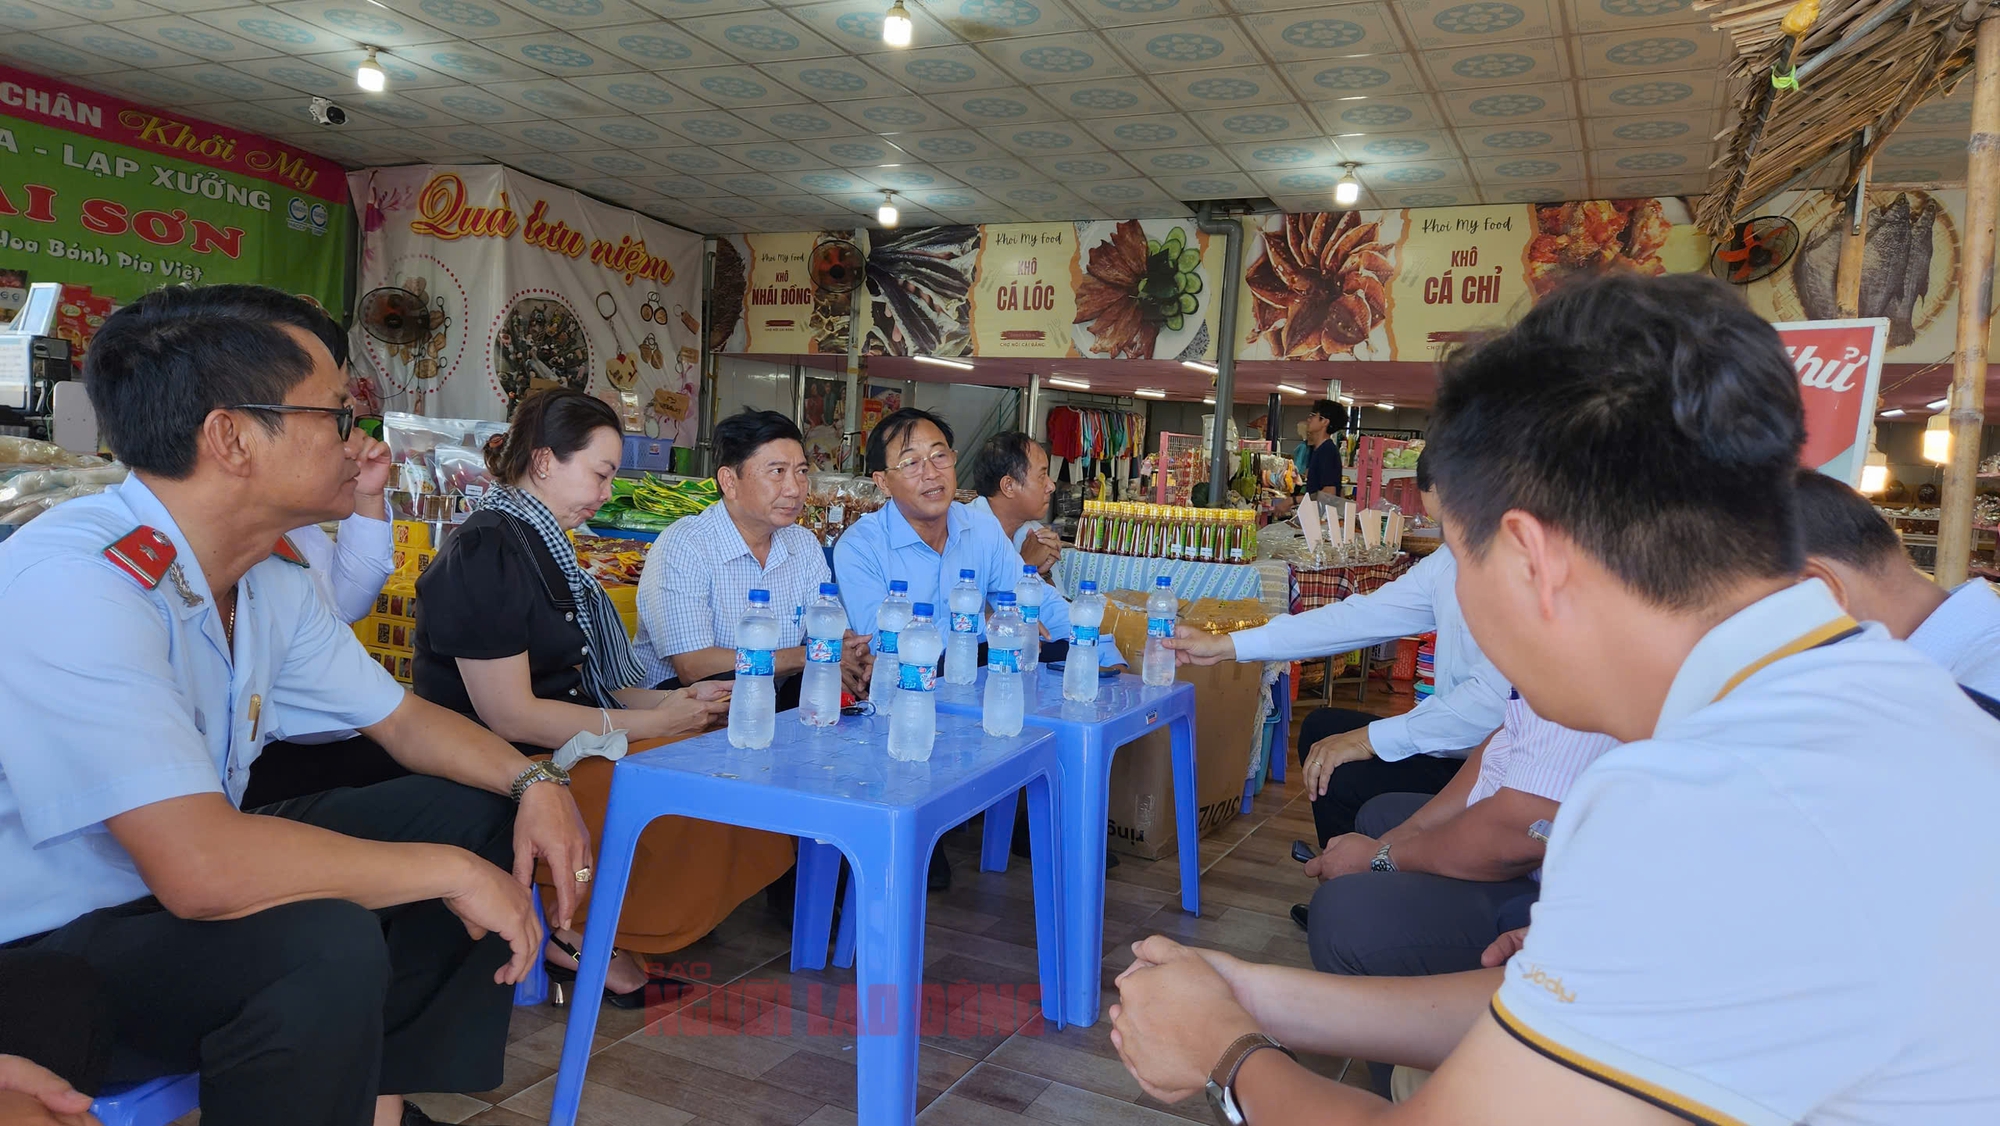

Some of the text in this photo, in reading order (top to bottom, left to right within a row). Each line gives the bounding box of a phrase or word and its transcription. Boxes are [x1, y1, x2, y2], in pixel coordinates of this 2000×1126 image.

[0, 81, 102, 129] CHÂN
[62, 143, 140, 178] LẠP
[151, 165, 272, 212] XƯỞNG
[244, 150, 319, 192] My
[81, 198, 246, 260] SƠN
[410, 173, 675, 286] Quà lưu niệm
[1020, 233, 1037, 247] My
[1041, 232, 1063, 245] Food
[1422, 216, 1513, 235] Khoi My Food
[48, 239, 109, 267] Bánh
[117, 251, 153, 274] Pía
[1017, 257, 1037, 275] KHÔ
[1451, 246, 1478, 267] KHÔ
[775, 269, 789, 282] KHÔ
[1423, 265, 1503, 304] CÁ CHỈ
[751, 284, 811, 305] NHÁI ĐỒNG
[997, 279, 1055, 311] CÁ LÓC
[1785, 346, 1869, 392] hử
